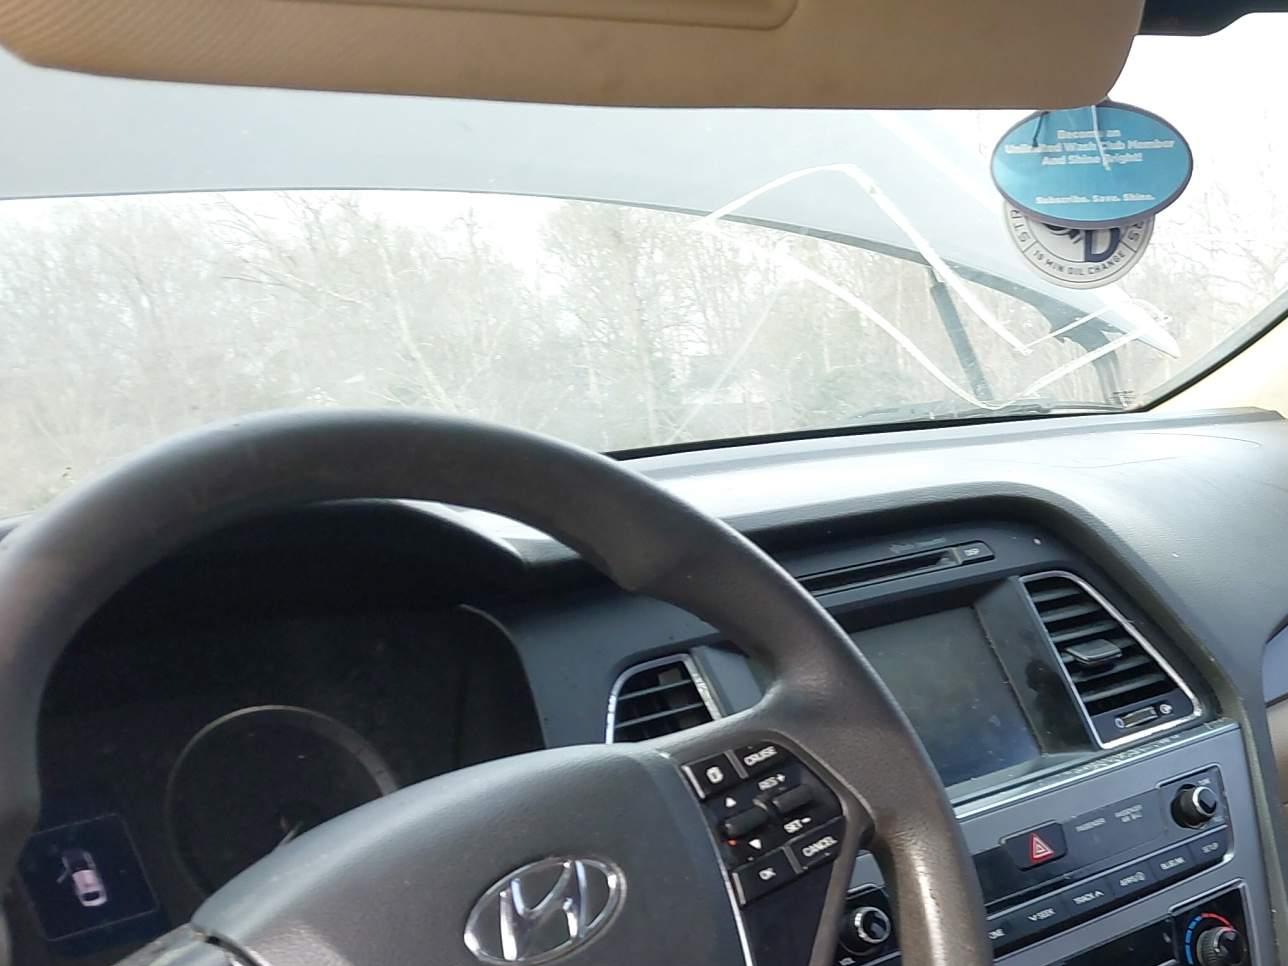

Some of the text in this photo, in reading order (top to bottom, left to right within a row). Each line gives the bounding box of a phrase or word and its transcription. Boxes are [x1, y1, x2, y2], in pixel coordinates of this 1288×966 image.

[1064, 141, 1098, 152] Wash
[1127, 138, 1175, 149] Member
[1041, 155, 1067, 166] And
[1068, 153, 1100, 165] Shine
[1045, 258, 1064, 273] MIN
[1067, 267, 1085, 276] OIL
[1087, 250, 1126, 275] CHANGE
[744, 745, 778, 767] CRUISE
[802, 835, 839, 857] CANCEL
